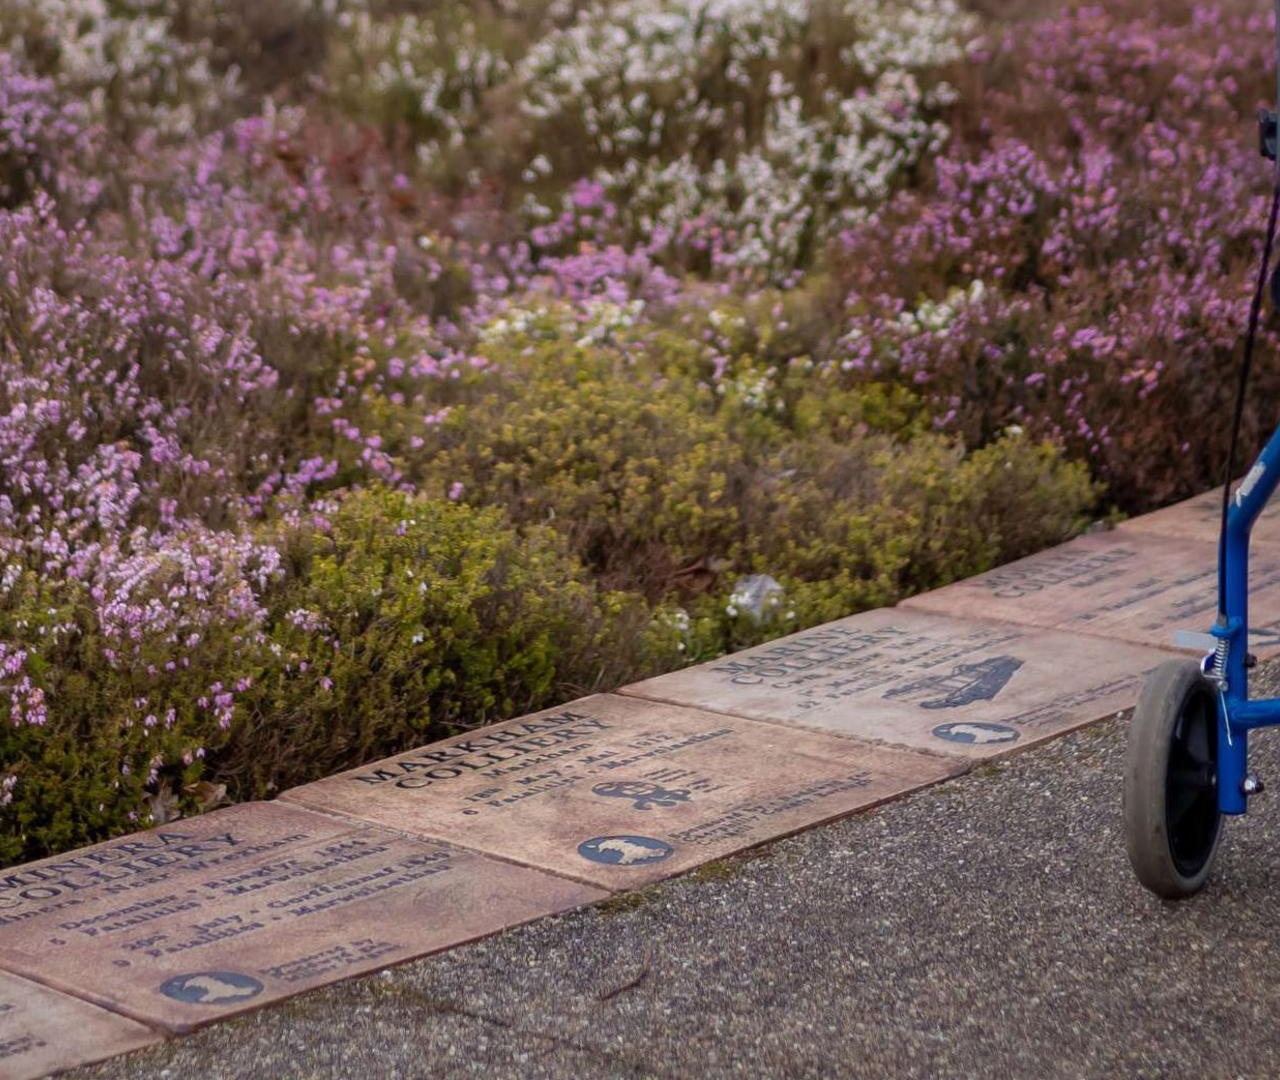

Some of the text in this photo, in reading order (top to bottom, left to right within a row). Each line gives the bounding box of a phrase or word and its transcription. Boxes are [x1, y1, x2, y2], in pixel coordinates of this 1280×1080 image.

[711, 626, 862, 675] MARINE
[730, 626, 909, 685] COLLIERY
[354, 710, 589, 786] MARKHAM
[396, 719, 613, 789] COLLIERY
[482, 741, 594, 779] Markham
[486, 774, 586, 808] Fatalities
[516, 768, 564, 787] May
[103, 871, 171, 895] Near
[178, 832, 311, 872] Wrexham
[57, 894, 178, 931] December
[79, 901, 202, 937] Fatalities
[189, 913, 244, 935] July
[144, 921, 265, 957] Fatalities
